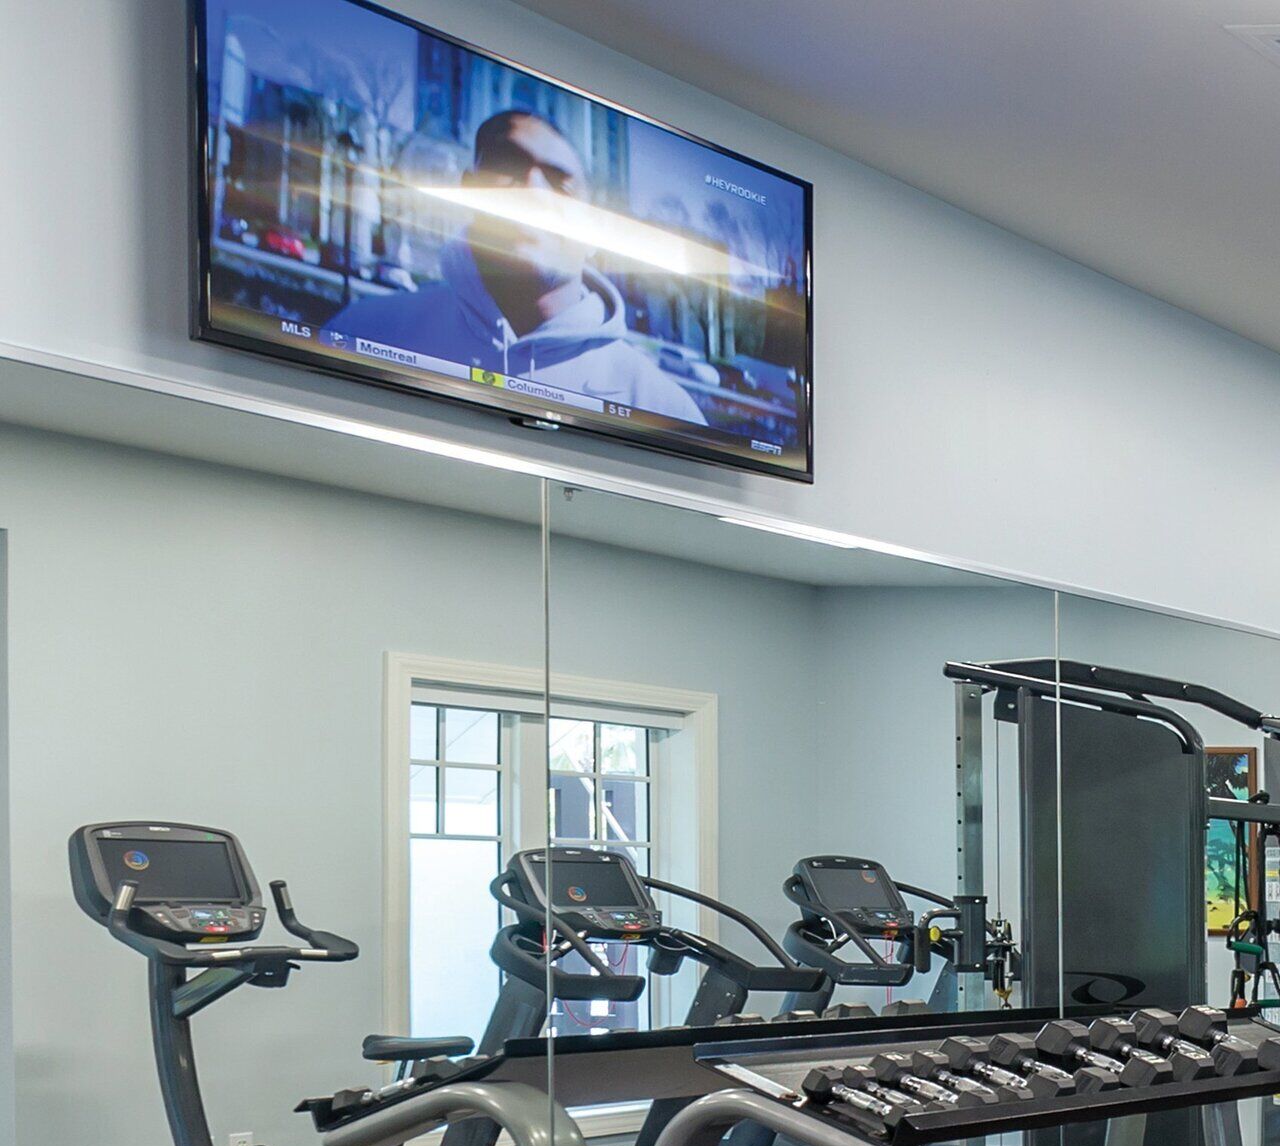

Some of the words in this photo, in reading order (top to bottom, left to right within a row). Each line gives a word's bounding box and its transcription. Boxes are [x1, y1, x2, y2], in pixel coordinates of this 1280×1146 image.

[281, 321, 311, 338] MLS
[360, 342, 417, 365] Montreal
[507, 379, 565, 402] Columbus
[618, 407, 632, 418] ET
